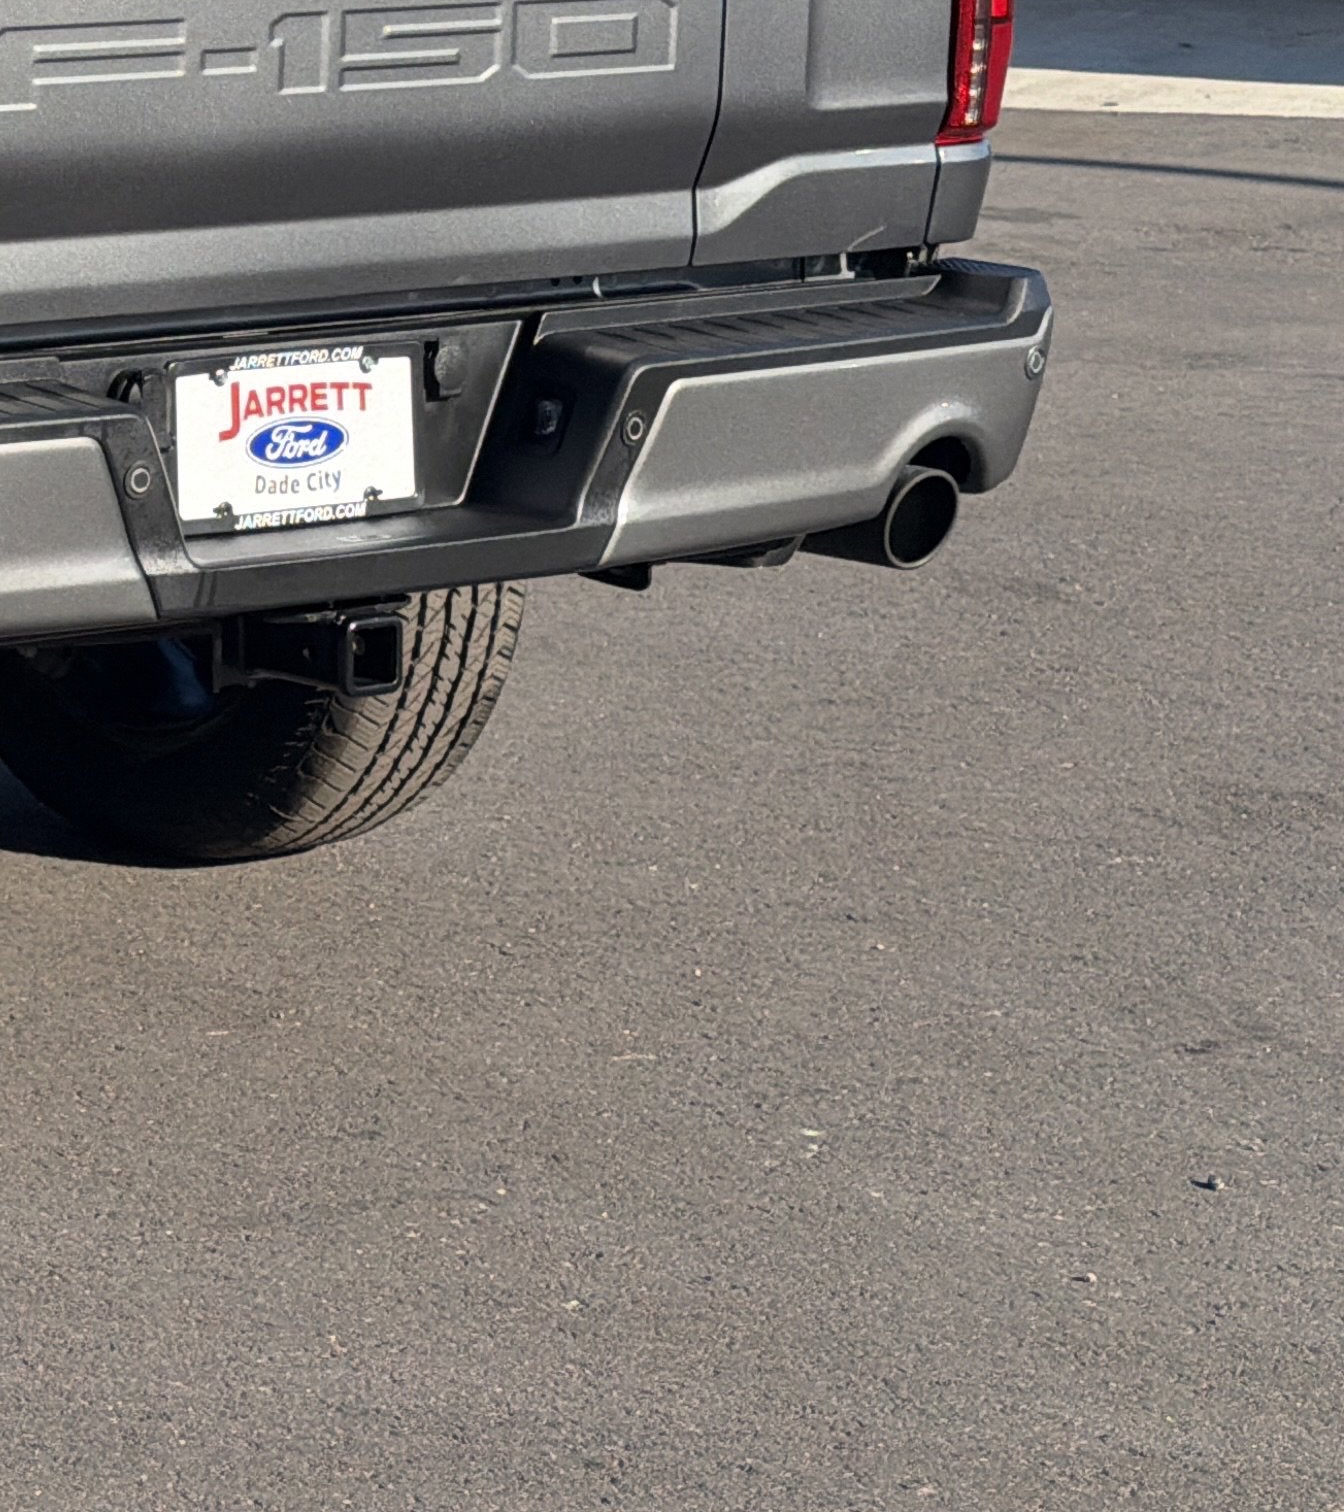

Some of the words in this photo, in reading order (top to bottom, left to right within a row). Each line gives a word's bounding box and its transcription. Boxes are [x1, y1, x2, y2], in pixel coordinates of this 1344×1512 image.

[229, 346, 364, 371] JARRETTFORD.COM
[219, 380, 373, 443] JARRETT
[265, 424, 327, 461] Ford
[255, 474, 300, 495] Dade
[306, 469, 342, 491] City
[234, 502, 368, 531] JARRETTFORD.COM
